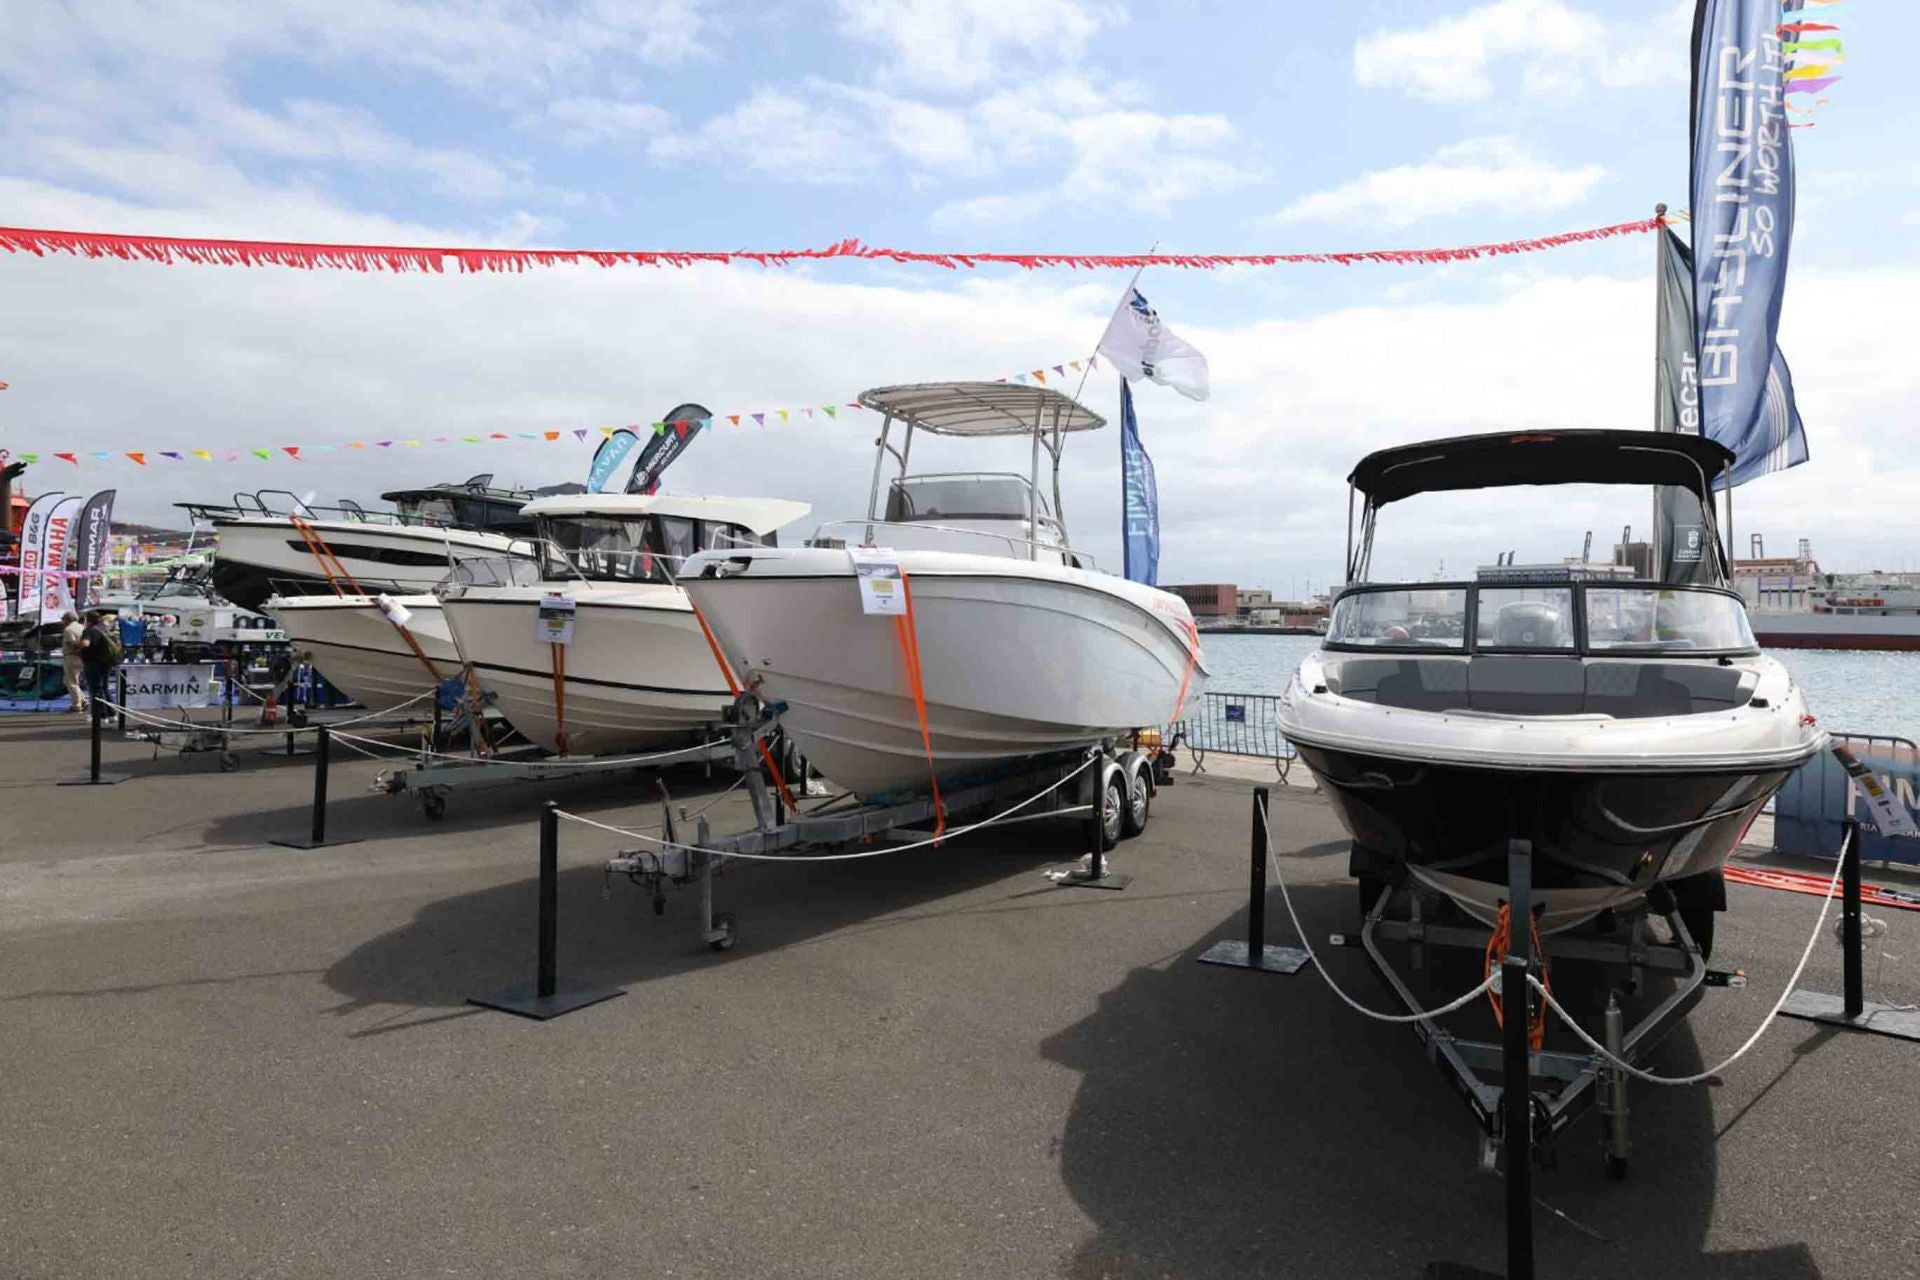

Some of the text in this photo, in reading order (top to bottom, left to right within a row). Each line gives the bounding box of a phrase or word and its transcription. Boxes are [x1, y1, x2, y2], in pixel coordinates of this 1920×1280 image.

[1752, 84, 1785, 194] WORTH
[1703, 46, 1757, 385] BAYLINER
[1751, 206, 1774, 257] SO
[1676, 351, 1699, 435] fecar
[645, 431, 677, 473] MERCURY
[28, 513, 41, 544] B&G
[22, 551, 37, 598] SIMAD
[126, 683, 200, 695] GARMIN
[1860, 822, 1878, 832] RIA
